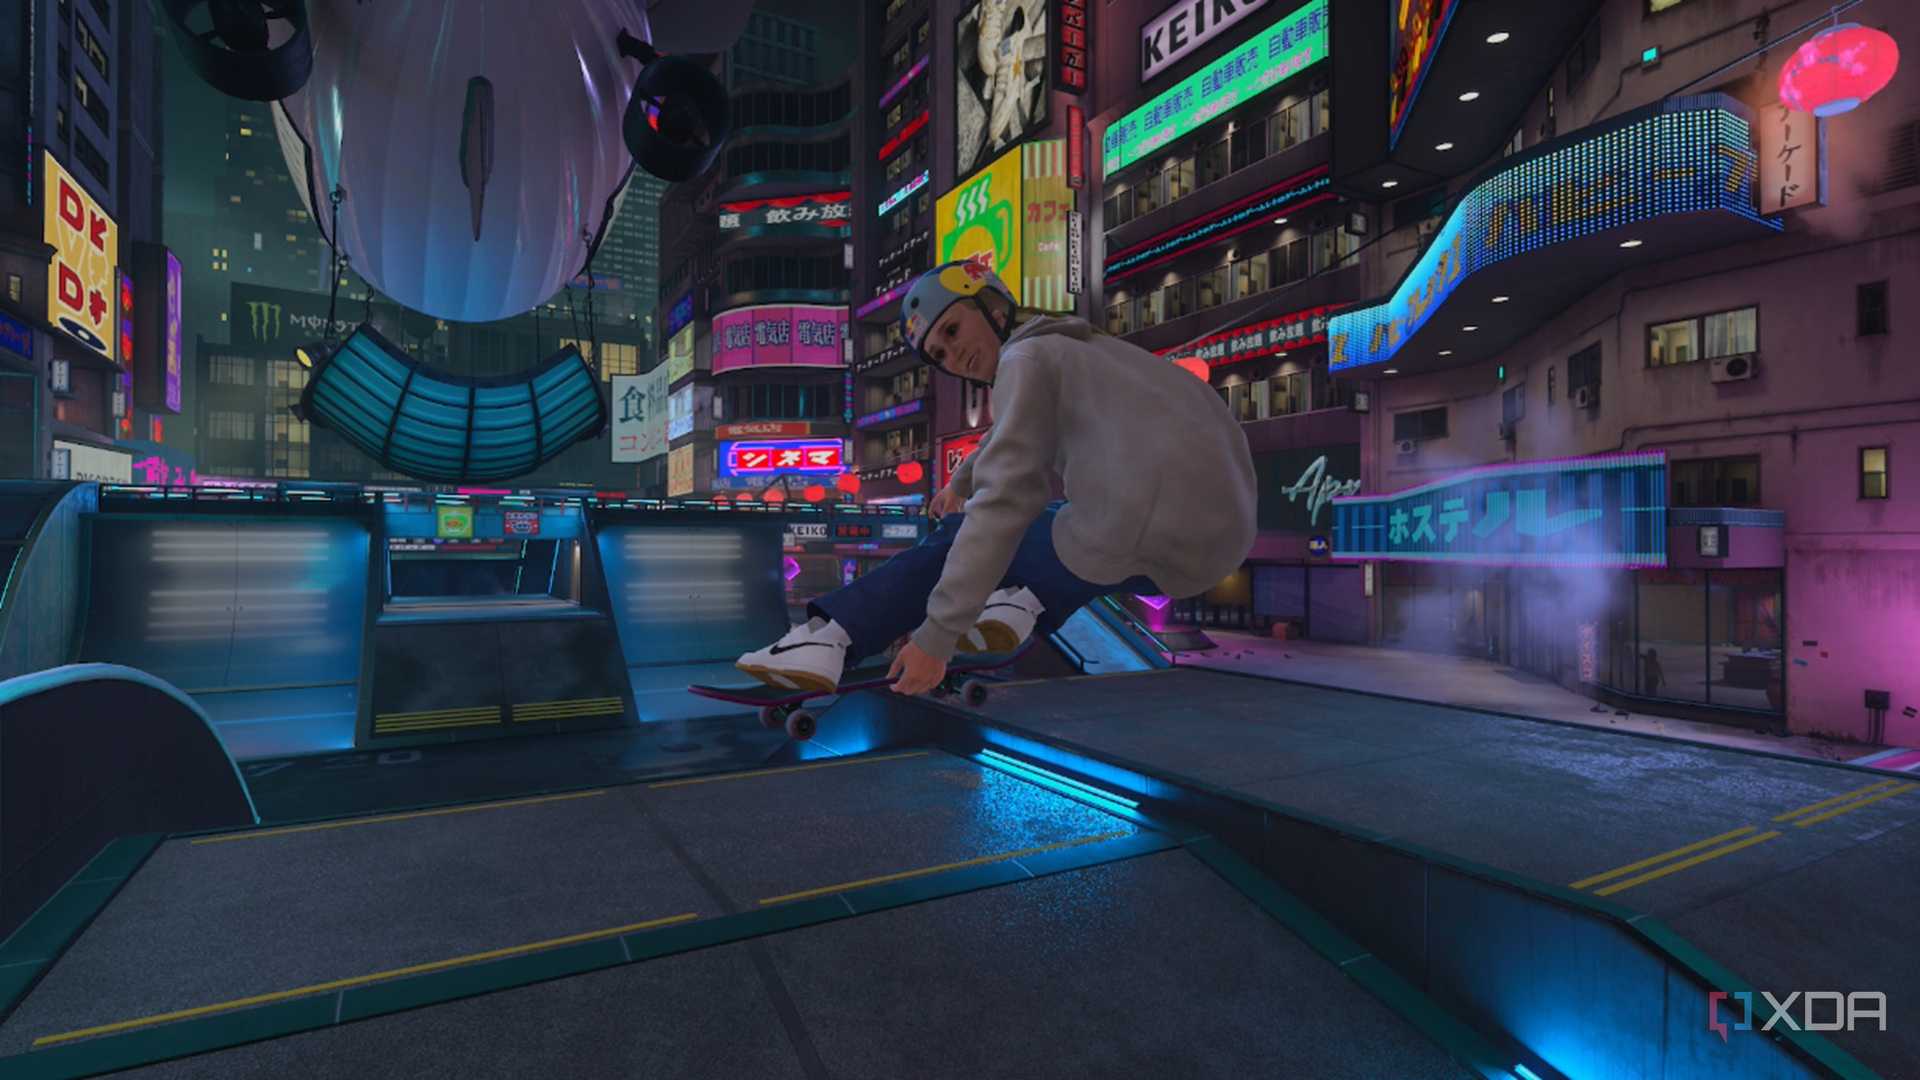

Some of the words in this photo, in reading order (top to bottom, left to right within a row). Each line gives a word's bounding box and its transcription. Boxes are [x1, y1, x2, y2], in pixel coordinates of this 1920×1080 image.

[1144, 0, 1262, 71] KEIK
[765, 204, 851, 224] 飲み放
[742, 450, 834, 468] シネマ
[1389, 488, 1602, 544] ホステル
